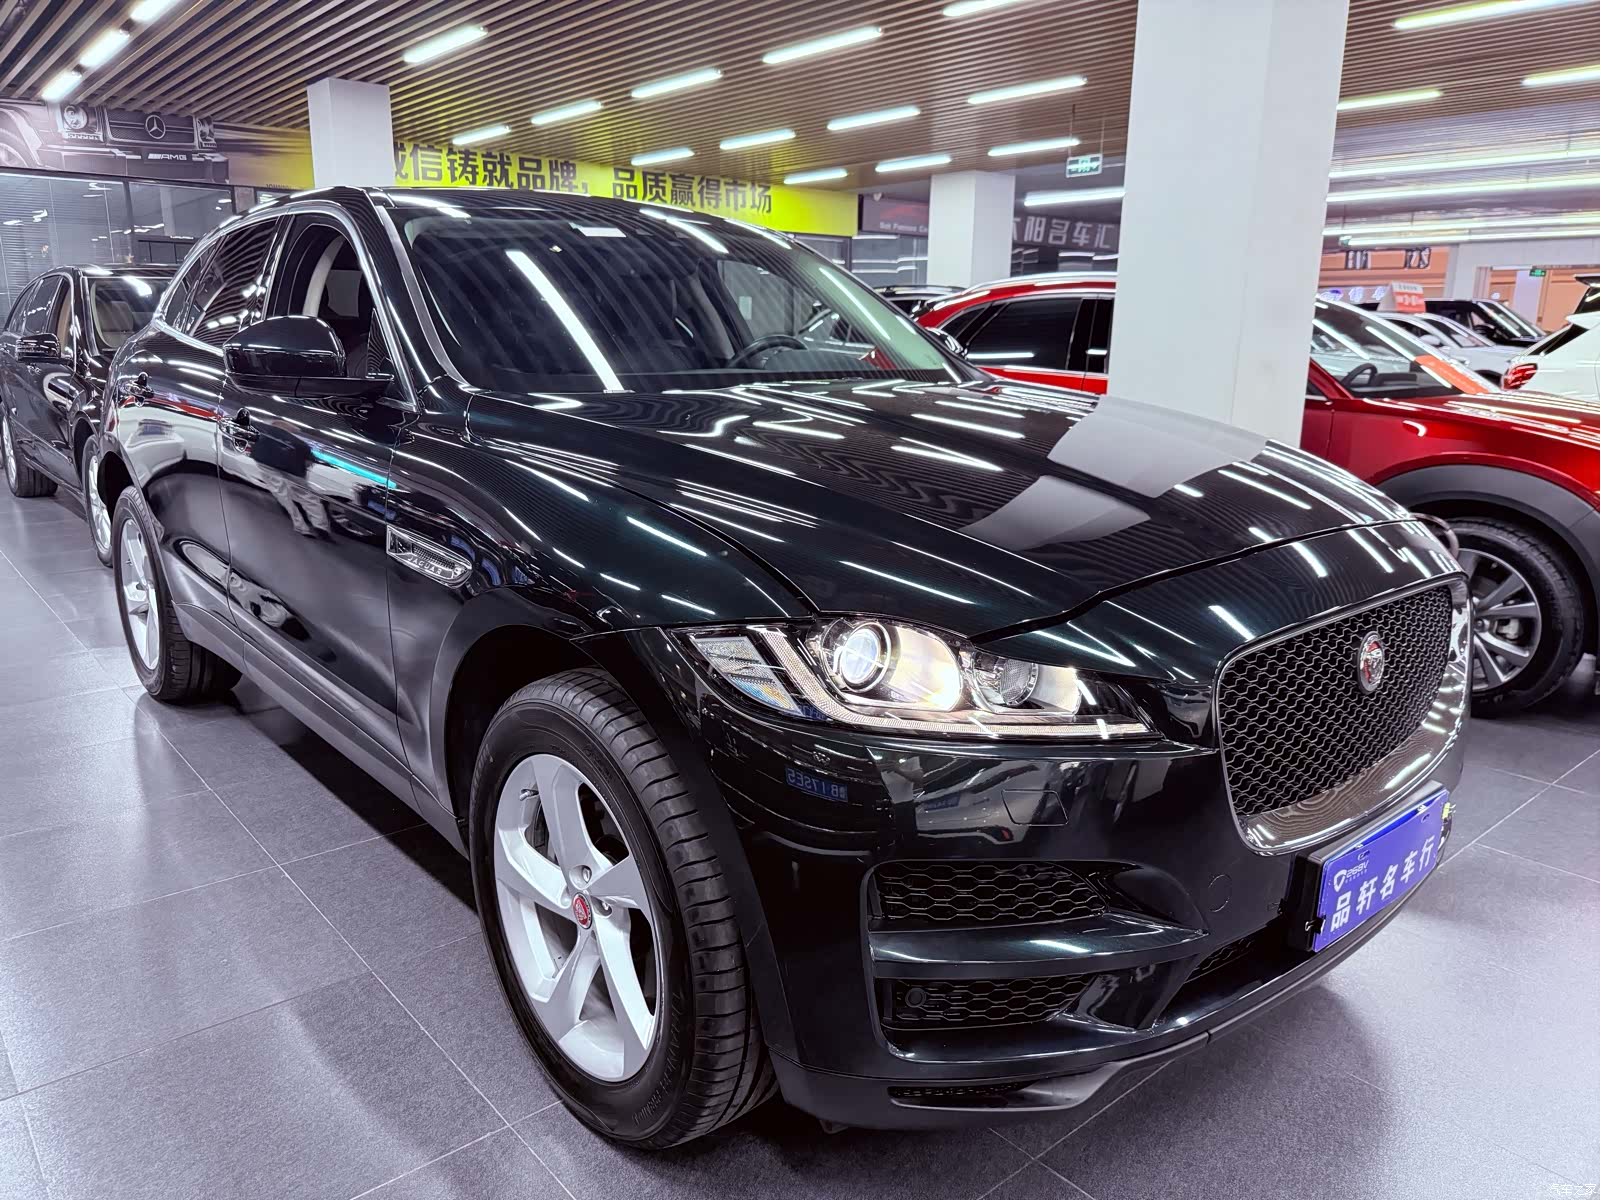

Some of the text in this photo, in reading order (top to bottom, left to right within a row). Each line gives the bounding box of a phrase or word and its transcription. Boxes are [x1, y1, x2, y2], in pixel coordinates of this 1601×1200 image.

[612, 167, 773, 213] 品质赢得市场
[407, 556, 443, 575] JAGUAR
[1330, 834, 1436, 933] 品轩名车行
